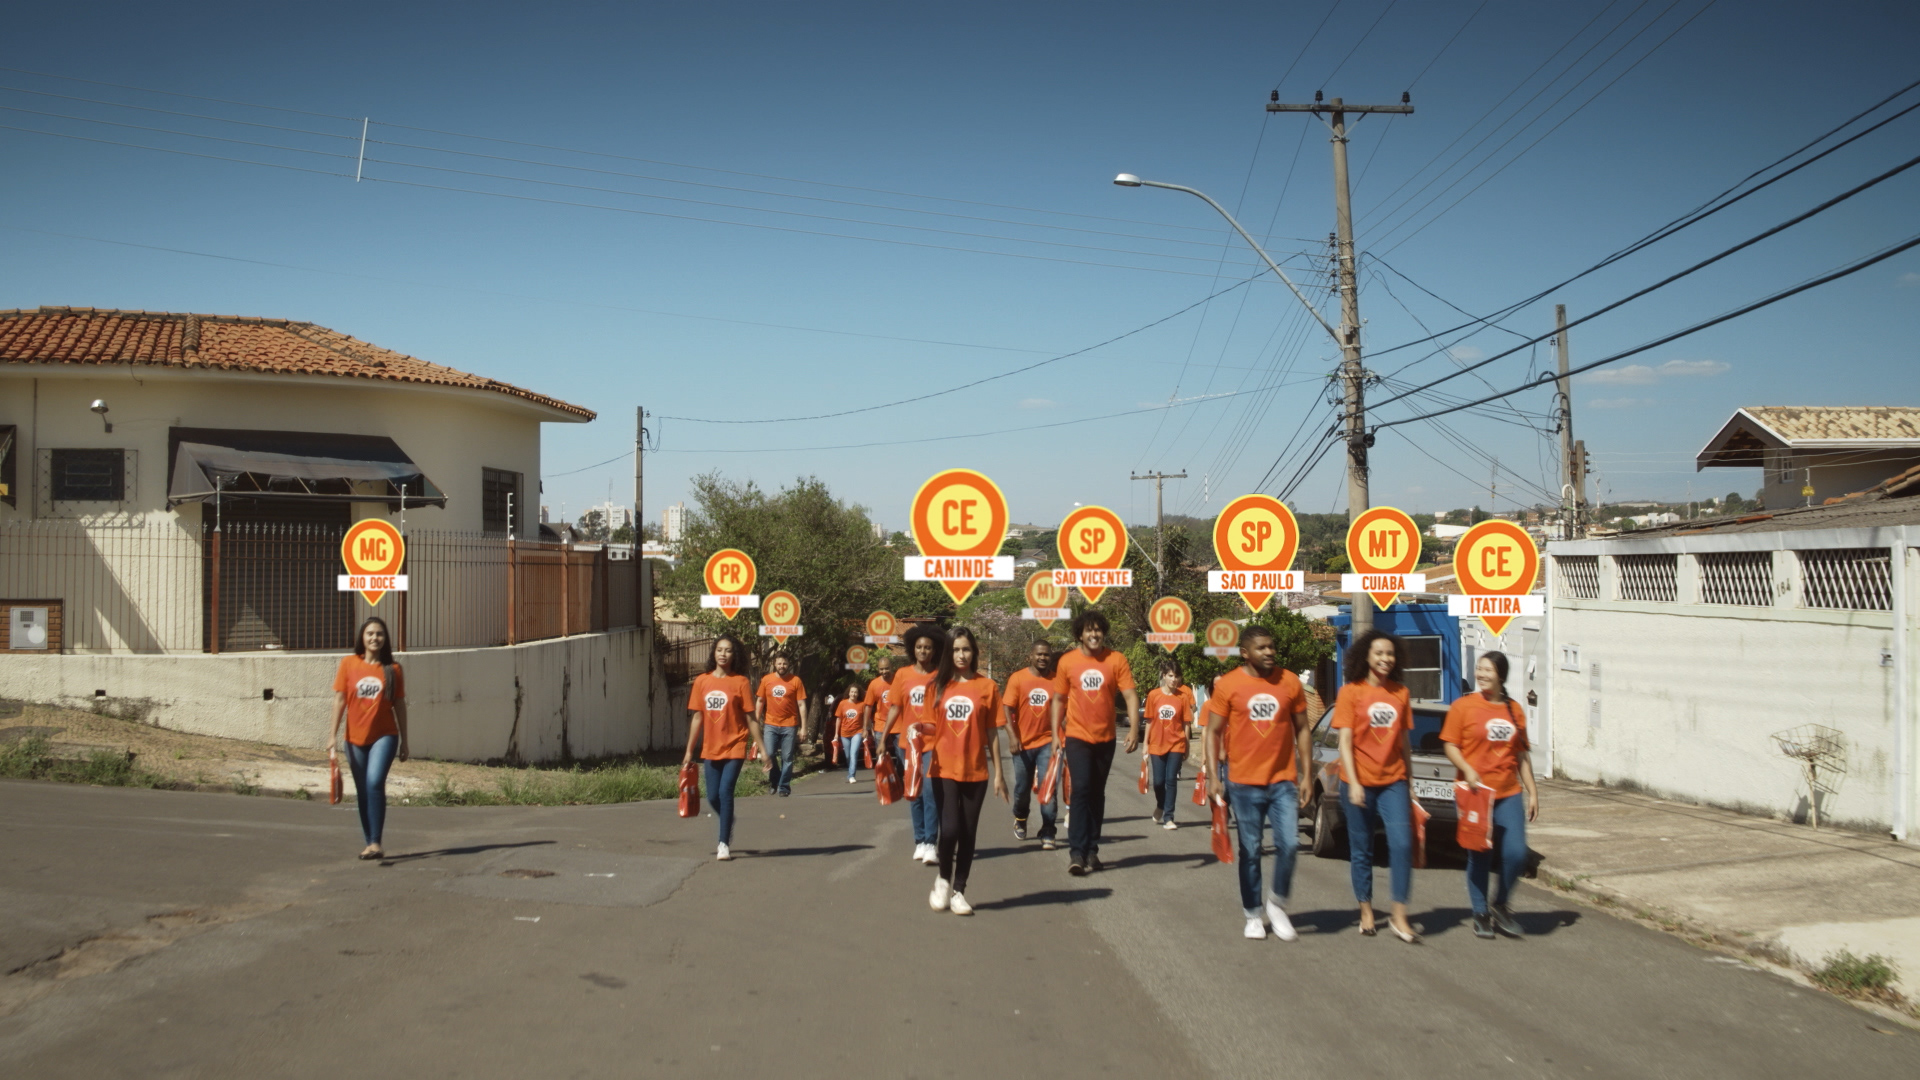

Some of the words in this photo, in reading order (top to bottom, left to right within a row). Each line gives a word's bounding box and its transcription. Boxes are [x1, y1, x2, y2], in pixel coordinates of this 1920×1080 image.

[1083, 676, 1102, 688] SBP
[359, 684, 380, 696] SBP
[773, 689, 785, 697] SBP
[707, 697, 726, 709] SBP
[1030, 693, 1047, 705] SBP
[948, 703, 971, 719] SBP
[1160, 709, 1175, 719] SBP
[1251, 703, 1276, 718] SBP
[1370, 710, 1394, 725] SBP
[1489, 725, 1511, 739] SBP
